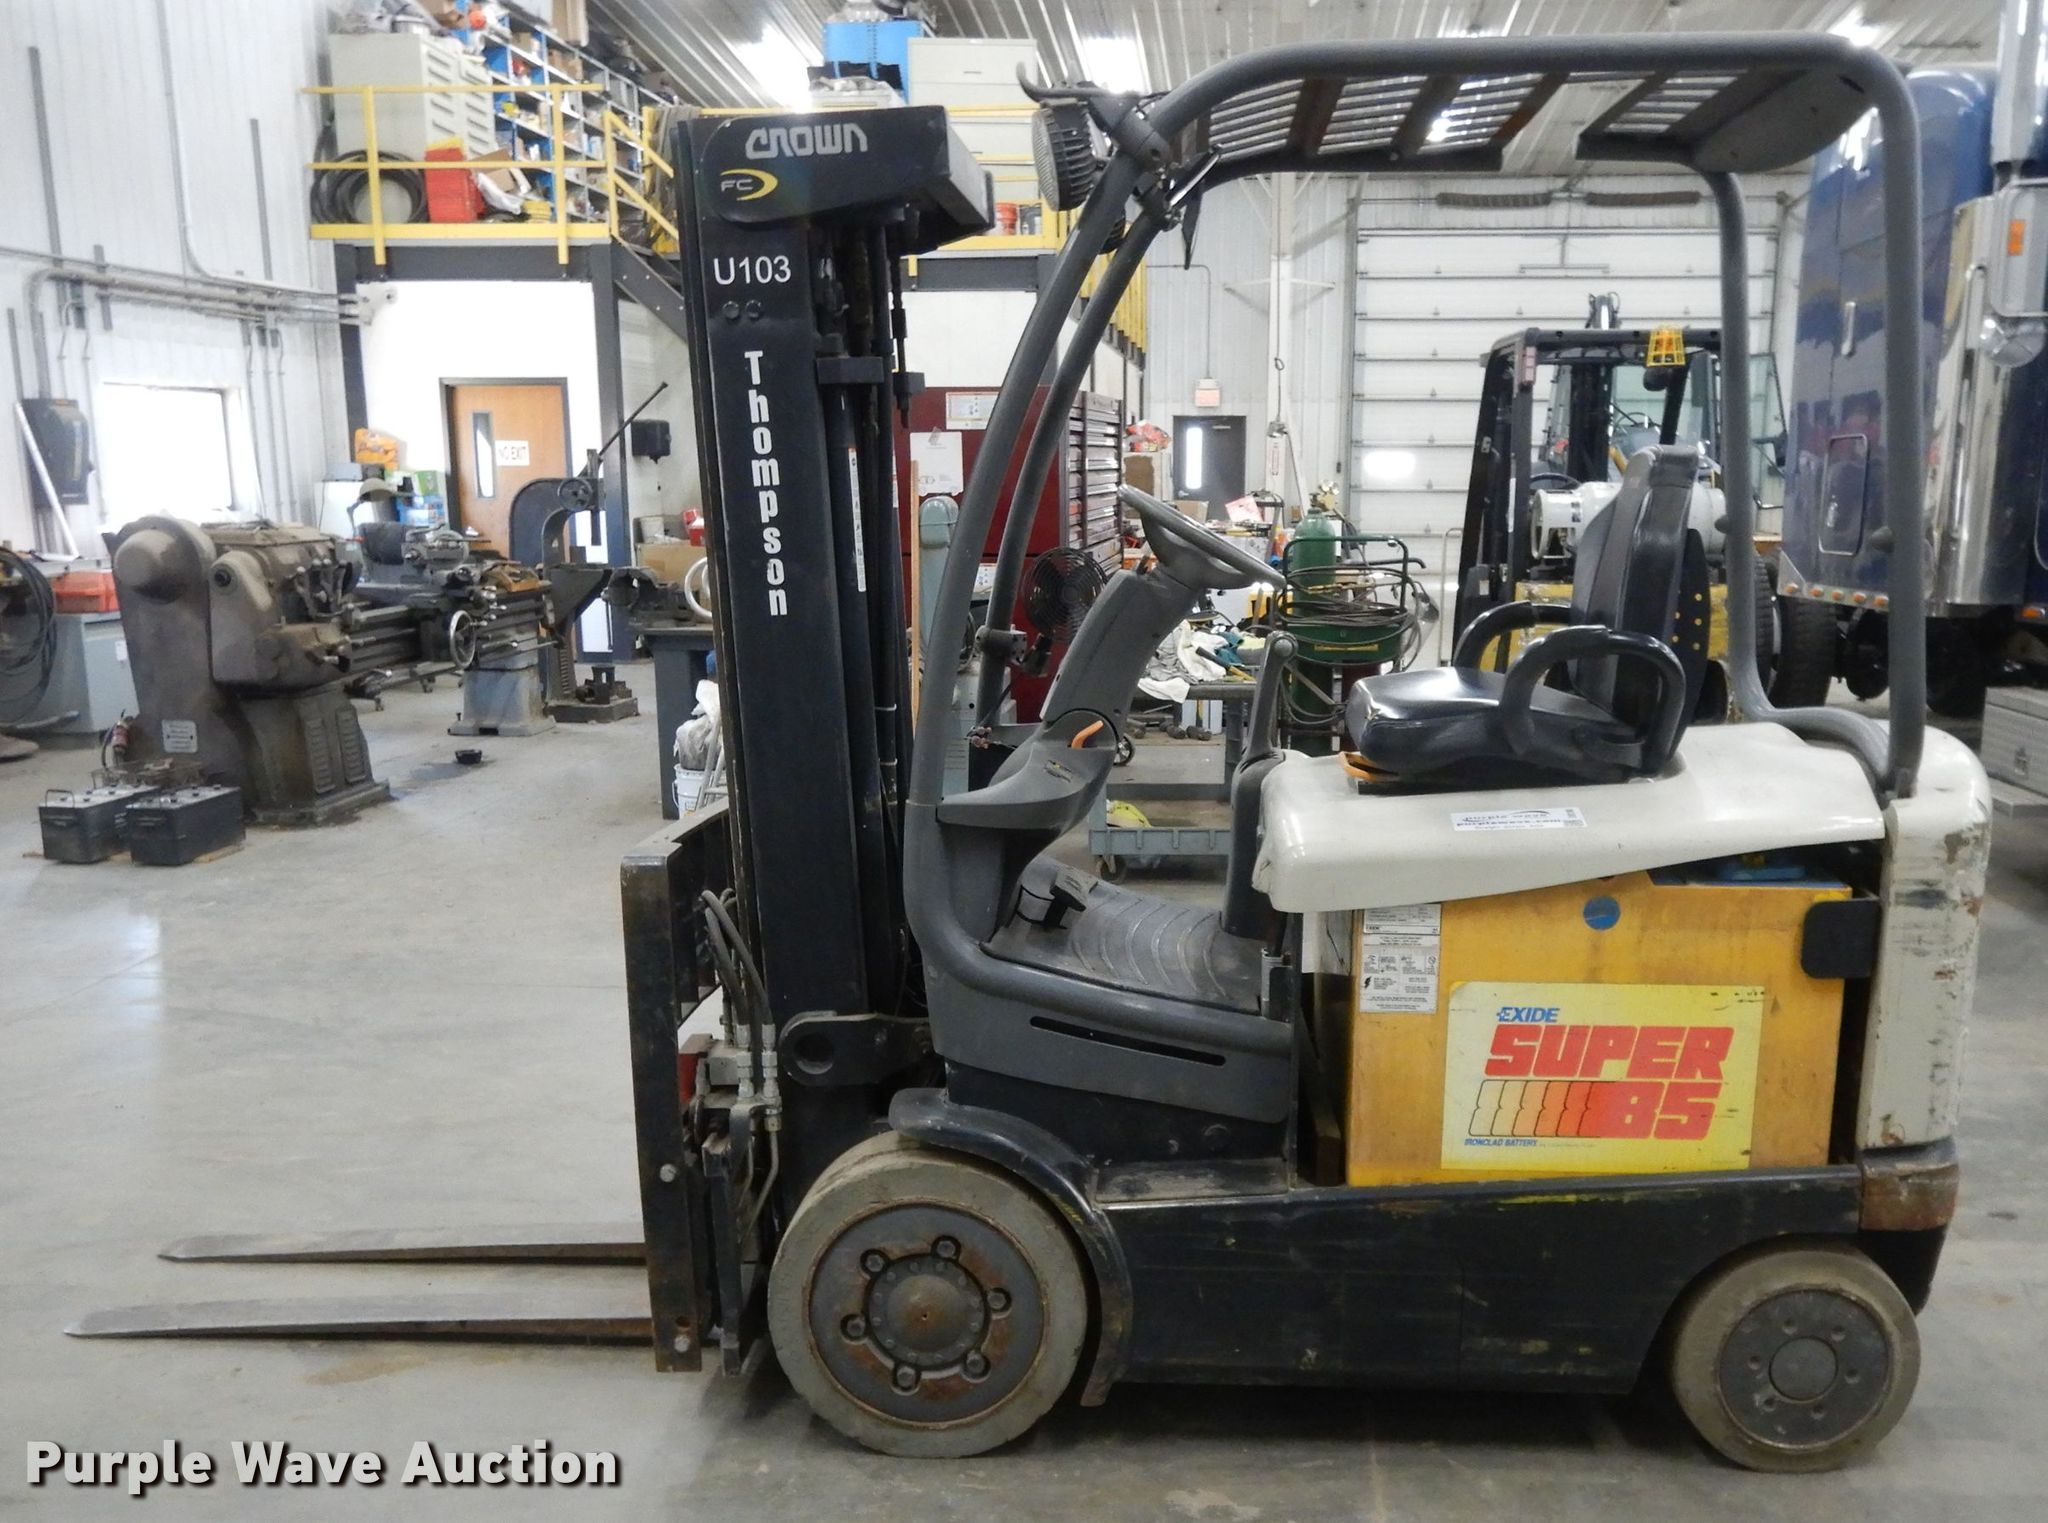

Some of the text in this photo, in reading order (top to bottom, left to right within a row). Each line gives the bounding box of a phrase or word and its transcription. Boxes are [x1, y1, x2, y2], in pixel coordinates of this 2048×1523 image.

[745, 123, 868, 160] CROWN
[720, 178, 754, 192] FC
[713, 255, 792, 285] U103
[744, 350, 788, 616] Thompson
[1496, 1006, 1560, 1023] EXIDE
[1485, 1024, 1735, 1080] SUPER
[1600, 1081, 1722, 1141] 85
[1464, 1138, 1503, 1147] IRONCLAD
[1504, 1138, 1538, 1147] BATTERY
